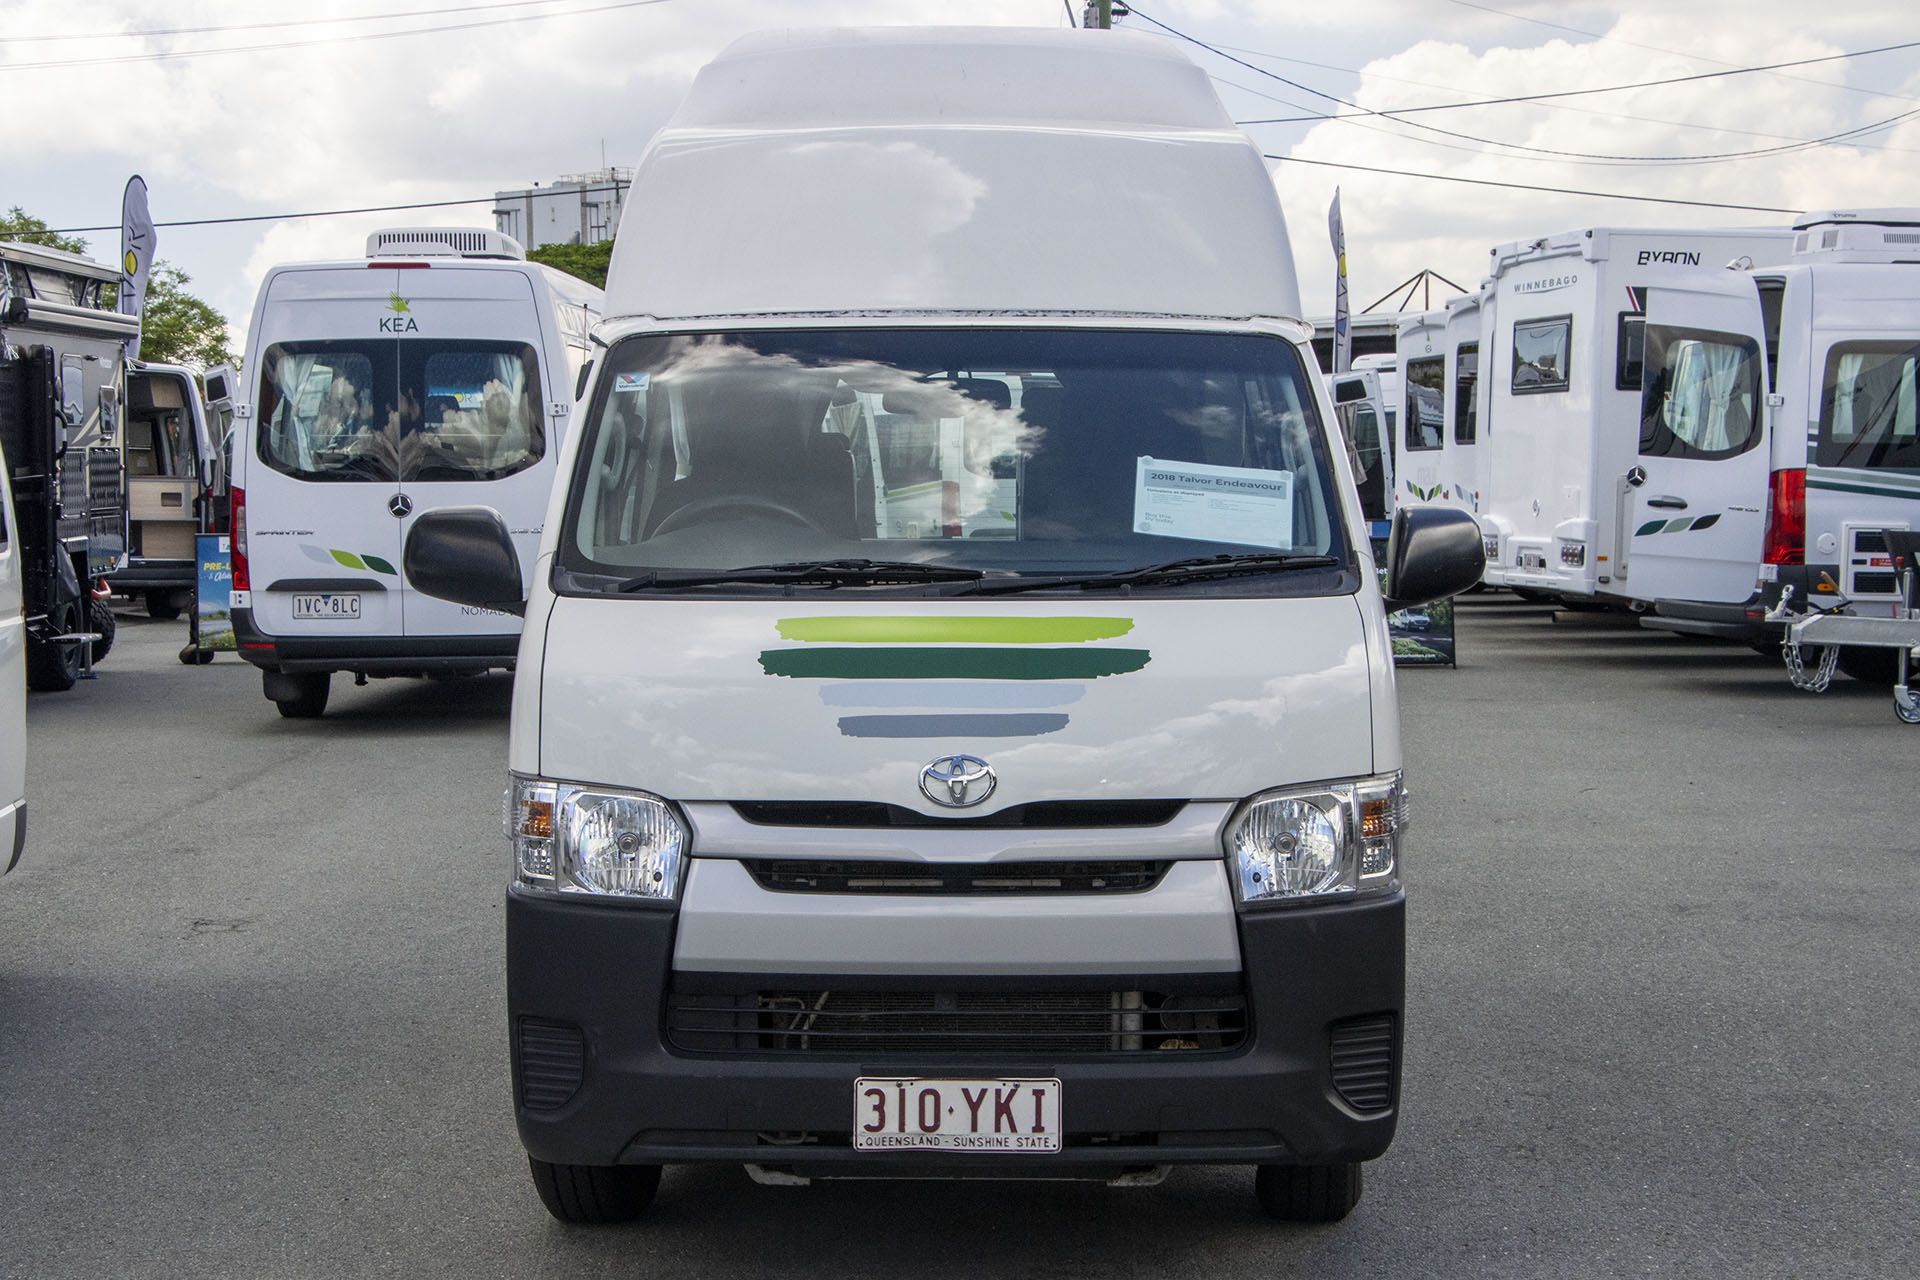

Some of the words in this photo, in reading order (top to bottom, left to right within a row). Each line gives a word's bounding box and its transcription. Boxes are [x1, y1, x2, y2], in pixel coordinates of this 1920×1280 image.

[1637, 251, 1701, 266] BYRON
[1513, 274, 1578, 293] WINNEBAGO
[379, 317, 419, 332] KEA
[1151, 472, 1176, 481] 2018
[1179, 475, 1212, 485] Talvor
[1215, 478, 1283, 492] Endeavour
[203, 562, 231, 571] PRE-L
[297, 598, 321, 613] 1VC
[332, 598, 358, 613] 8LC
[865, 1137, 940, 1147] QUEENSLAND
[953, 1137, 1009, 1147] SUNSHINE
[1016, 1138, 1050, 1148] STATE
